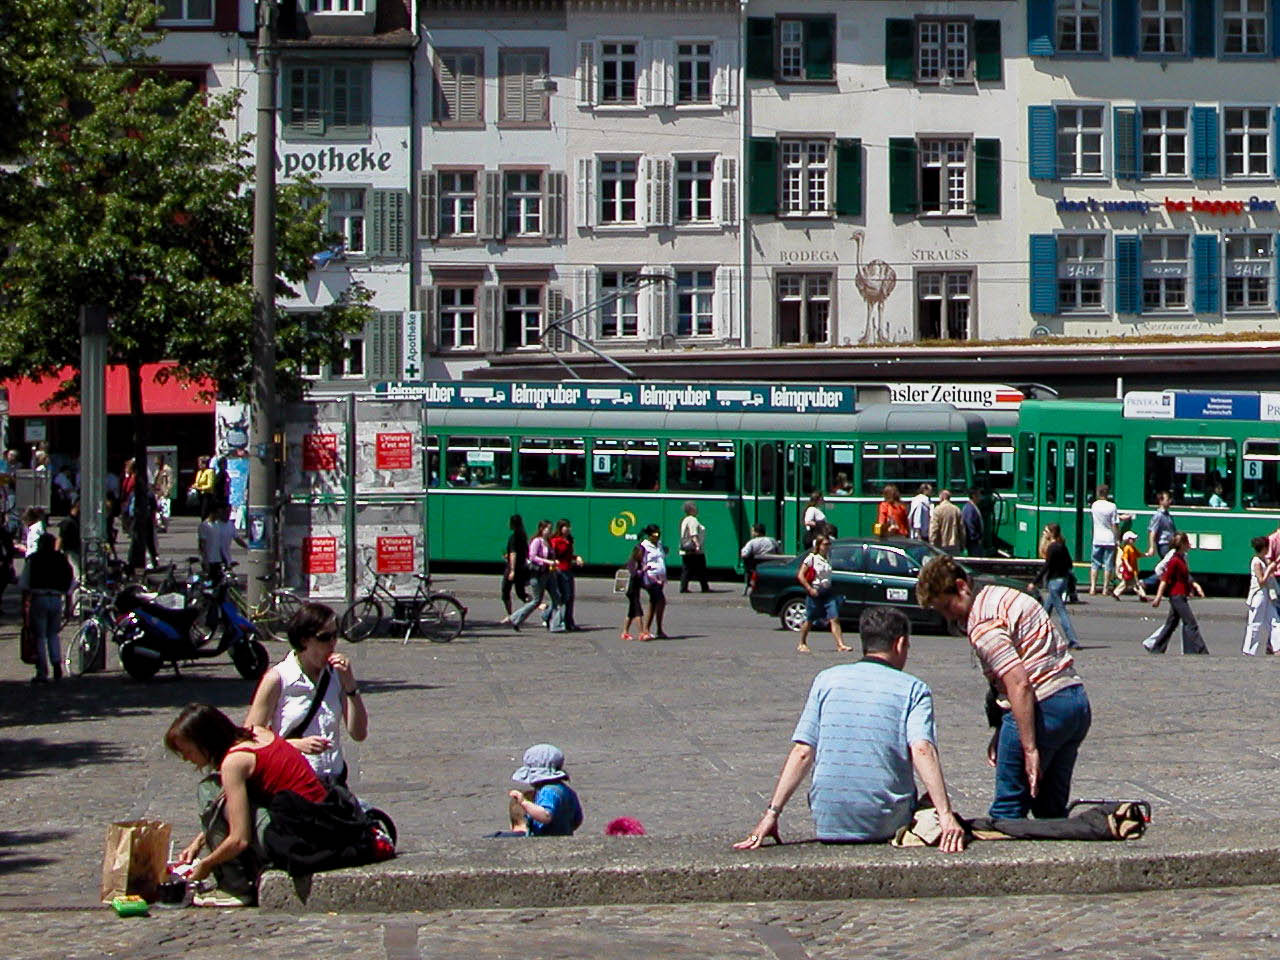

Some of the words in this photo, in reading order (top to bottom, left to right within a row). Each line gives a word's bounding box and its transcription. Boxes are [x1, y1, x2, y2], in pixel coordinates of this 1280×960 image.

[275, 147, 392, 178] potheke
[780, 250, 840, 262] BODEGA
[911, 249, 969, 261] STRAUSS
[407, 313, 418, 362] Apotheke
[511, 383, 581, 409] leimgruber
[640, 384, 711, 411] leimgruber
[770, 386, 843, 412] leimgruber
[890, 385, 929, 403] asler
[931, 385, 993, 406] Zeitung
[598, 456, 606, 470] 6
[1249, 461, 1257, 477] 6
